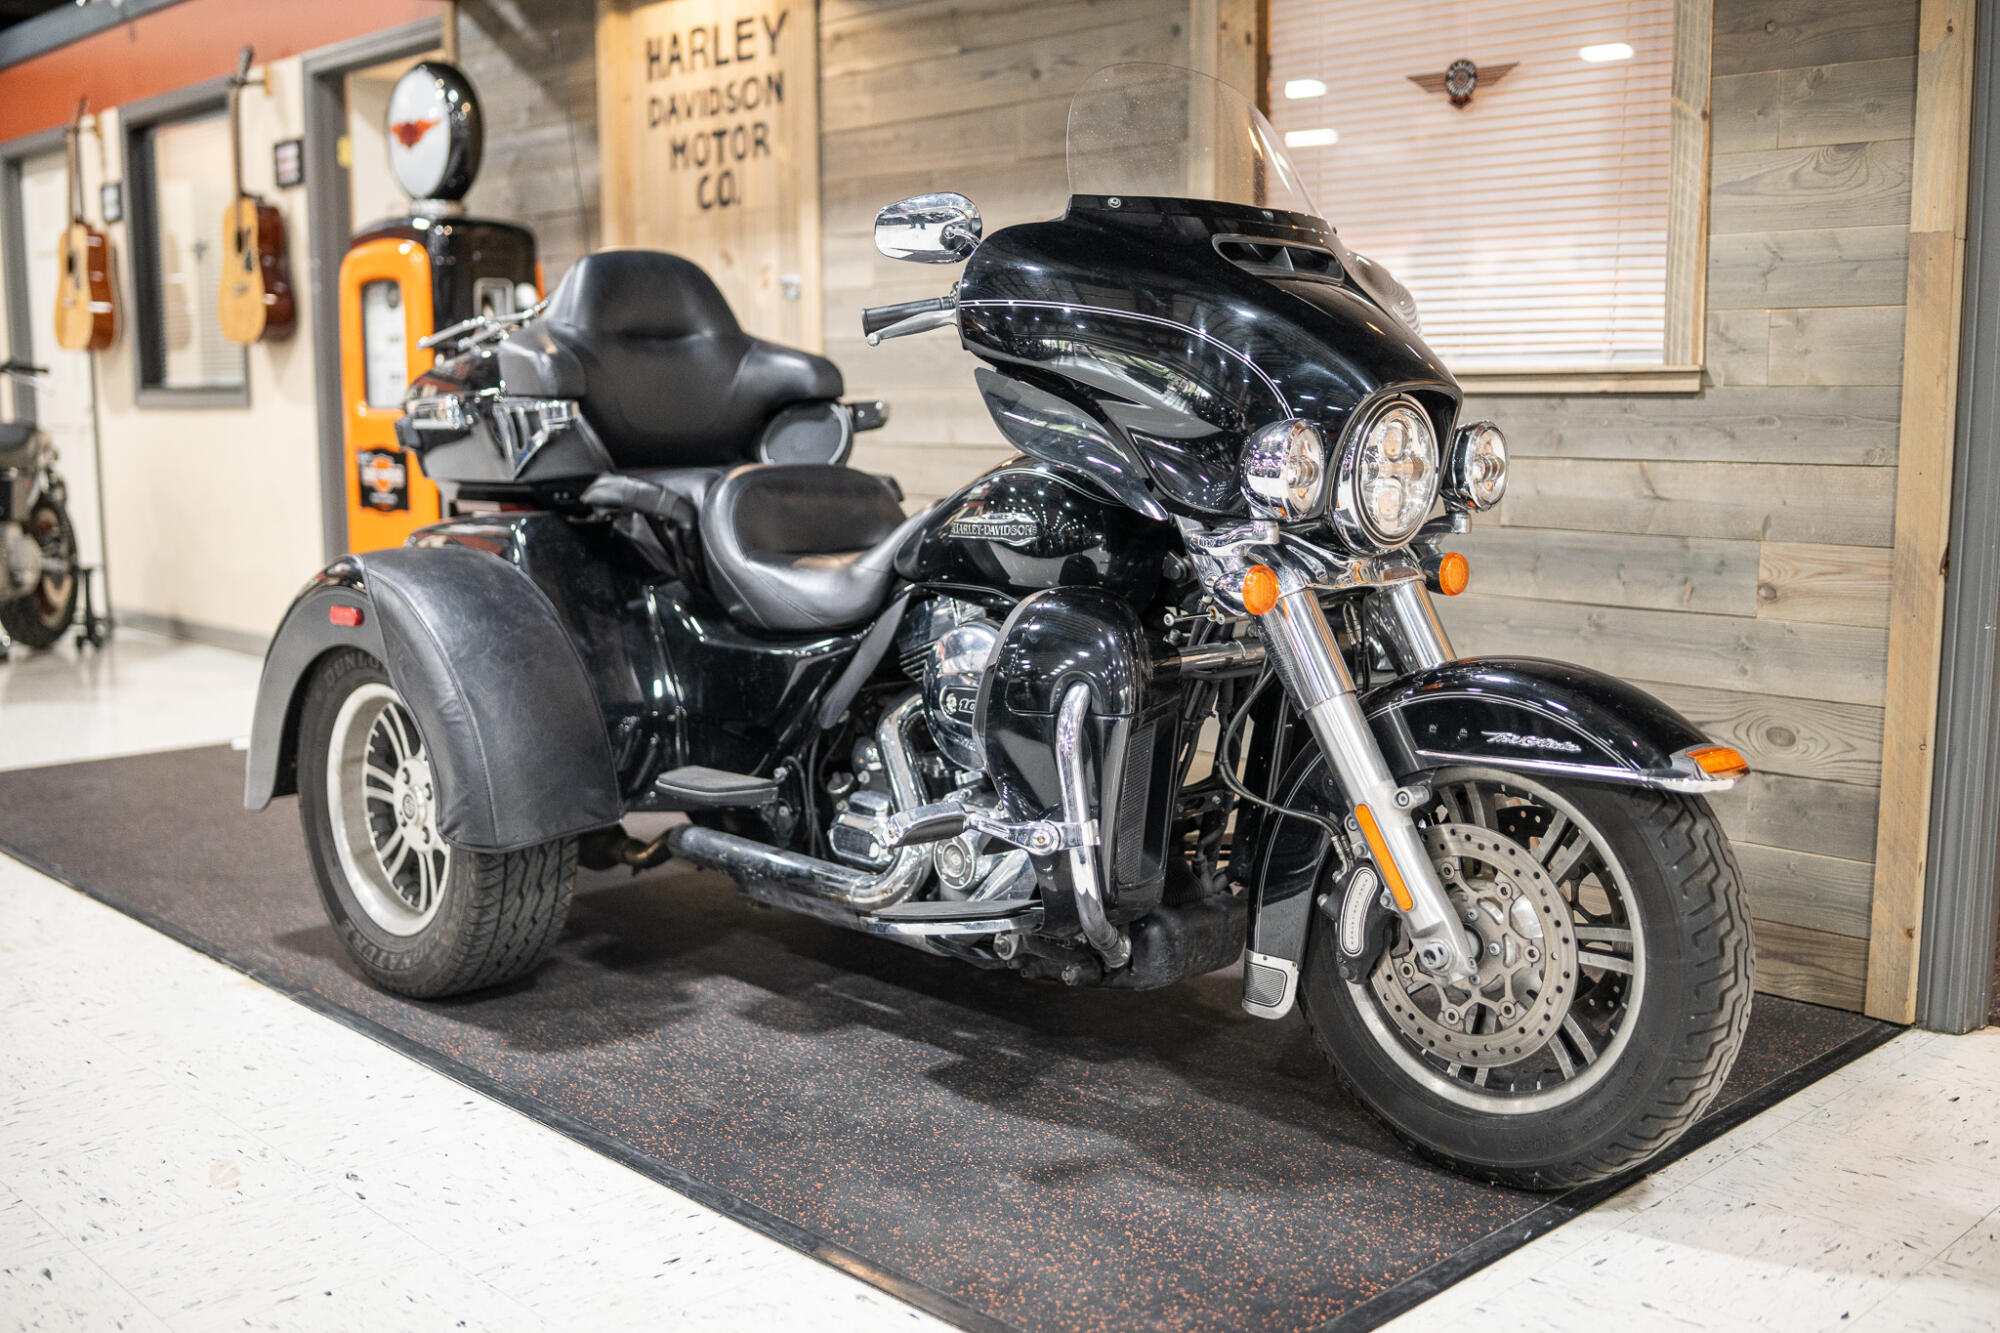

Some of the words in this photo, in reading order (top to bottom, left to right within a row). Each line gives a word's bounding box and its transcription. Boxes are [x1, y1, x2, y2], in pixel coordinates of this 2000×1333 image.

[647, 10, 789, 81] HARLEY
[649, 73, 784, 128] DAVIDSON
[670, 122, 771, 171] MOTOR
[951, 523, 1033, 536] HARLEY-DAVIDSON
[323, 652, 381, 688] DUNLO
